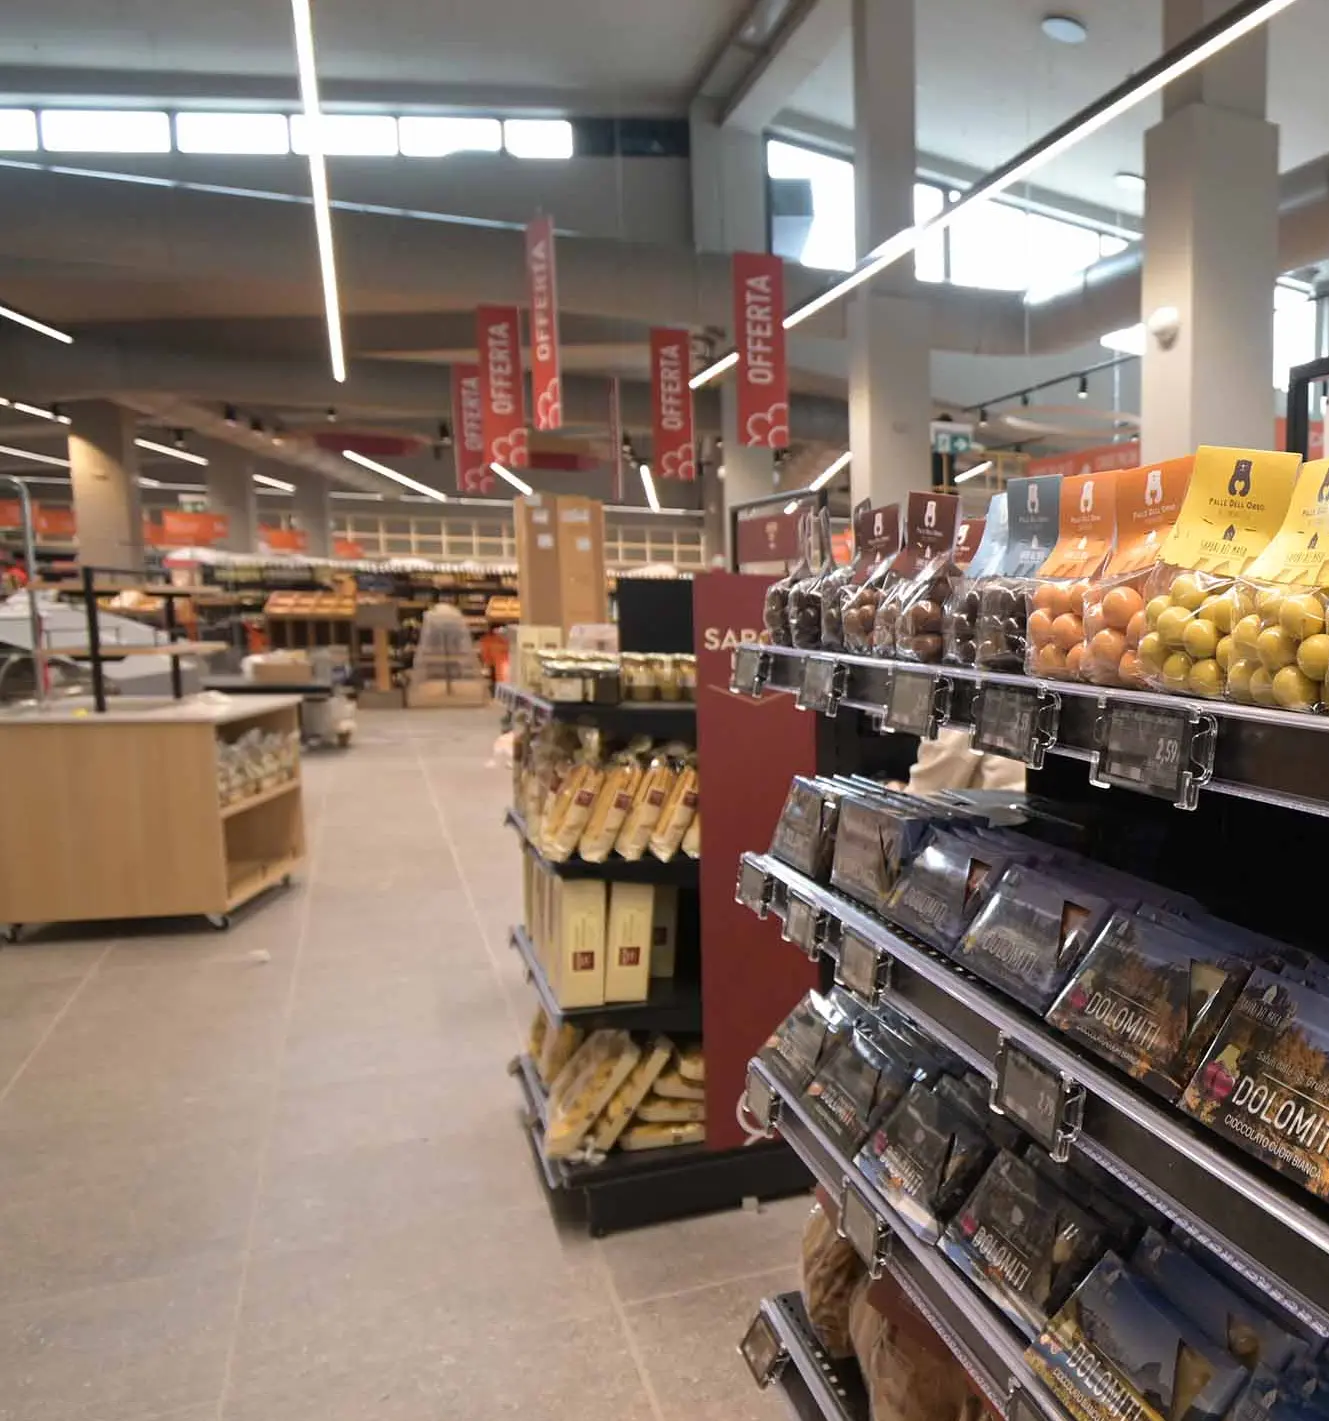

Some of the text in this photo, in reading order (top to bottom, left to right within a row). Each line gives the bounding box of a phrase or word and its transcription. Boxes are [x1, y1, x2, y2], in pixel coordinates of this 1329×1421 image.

[532, 240, 551, 363] OFFERTA
[746, 274, 773, 386] OFFERTA
[487, 322, 515, 415] OFFERTA
[660, 343, 682, 431] OFFERTA
[1084, 991, 1161, 1051] DOLOMITI
[1224, 1114, 1269, 1148] CIOCCOLATO
[972, 1225, 1033, 1291] DOLOMITI
